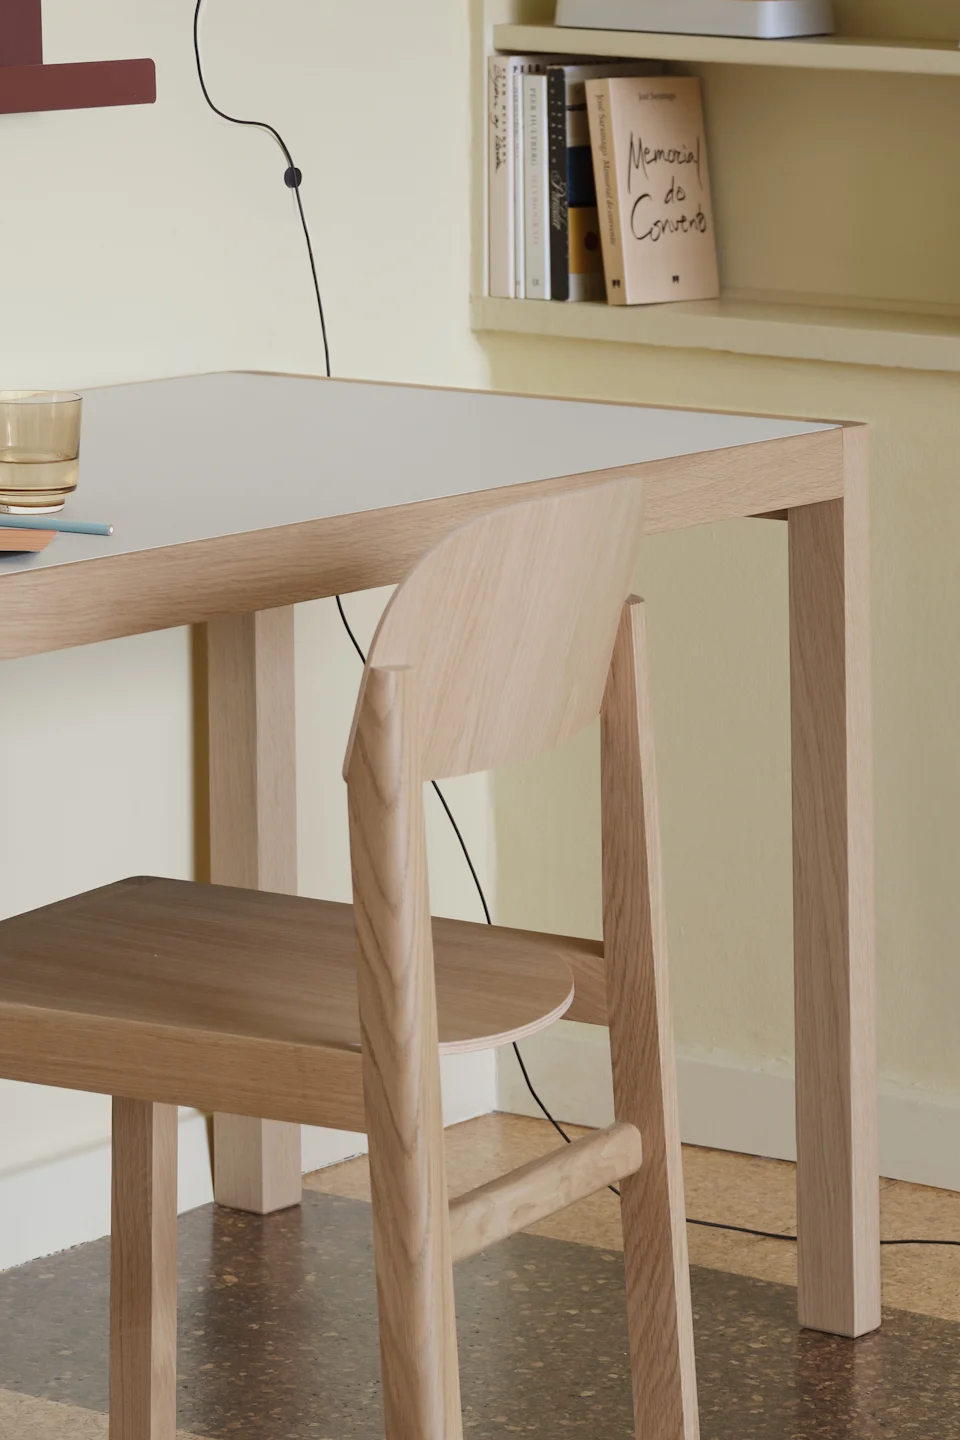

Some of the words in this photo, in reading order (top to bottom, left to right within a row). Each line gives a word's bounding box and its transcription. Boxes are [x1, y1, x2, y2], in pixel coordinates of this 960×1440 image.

[595, 94, 605, 112] José
[530, 115, 538, 166] HULTBERG
[598, 114, 608, 157] Saramago
[602, 159, 612, 197] Memorial
[627, 131, 704, 195] Memorial
[664, 175, 686, 205] do
